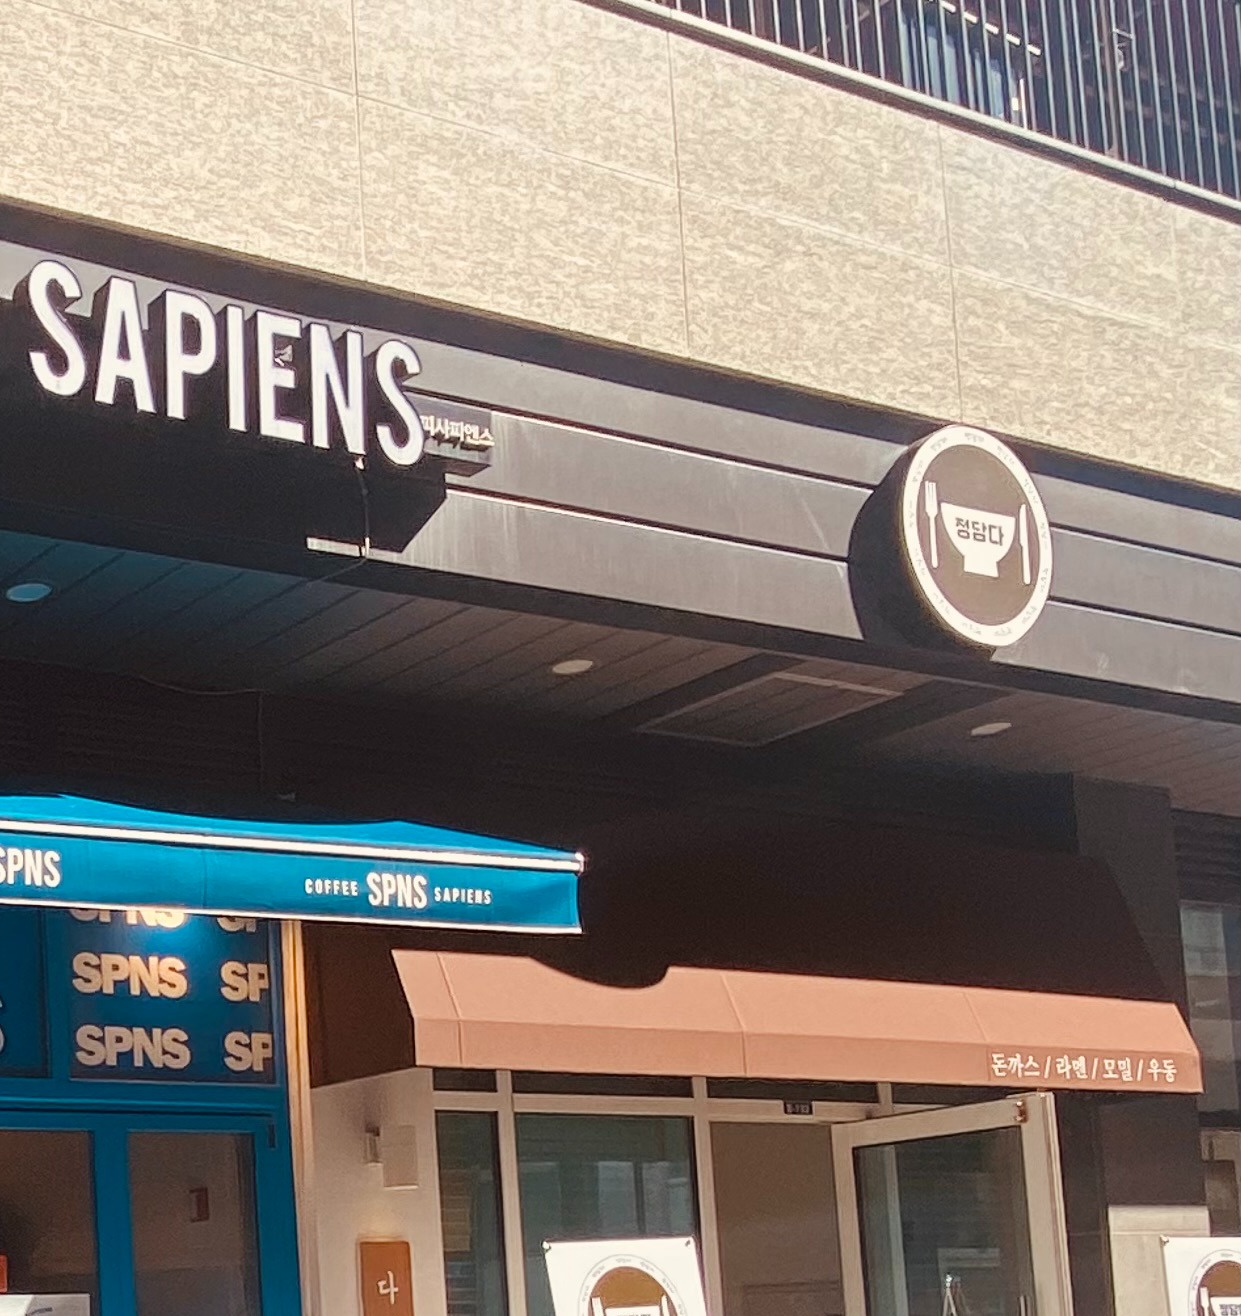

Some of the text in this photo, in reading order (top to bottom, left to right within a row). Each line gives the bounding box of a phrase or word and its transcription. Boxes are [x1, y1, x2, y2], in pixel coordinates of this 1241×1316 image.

[28, 260, 426, 467] SAPIENS
[955, 517, 1004, 546] 정담다
[305, 872, 492, 909] COFFEE SPNS SAPIENS
[72, 952, 188, 999] SPNS
[75, 1024, 191, 1070] SPNS
[991, 1053, 1040, 1079] 돈까스
[1055, 1055, 1088, 1080] 라멘
[1147, 1058, 1177, 1083] 우동
